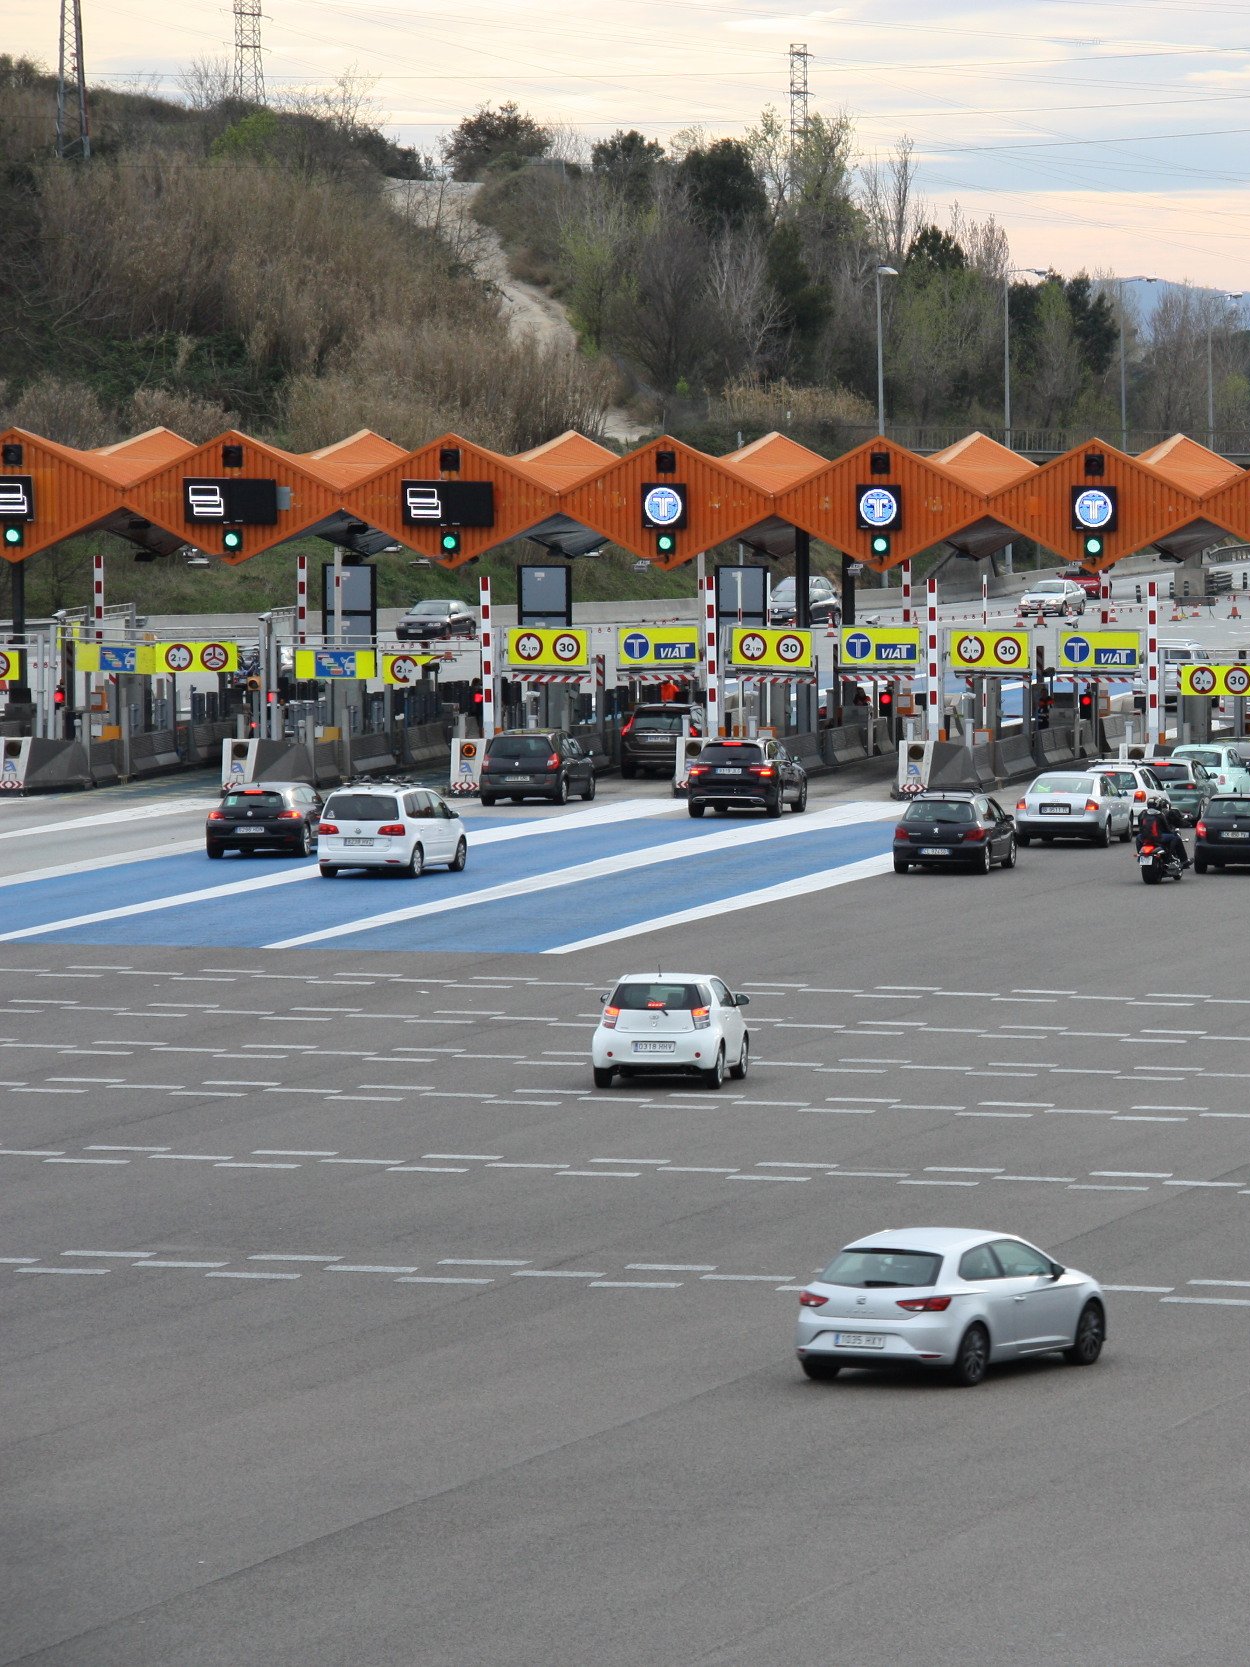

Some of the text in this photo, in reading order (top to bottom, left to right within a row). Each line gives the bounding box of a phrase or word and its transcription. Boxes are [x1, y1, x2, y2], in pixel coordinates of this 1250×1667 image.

[559, 643, 575, 652] 30
[782, 644, 798, 653] 30
[1000, 646, 1016, 655] 30
[1229, 676, 1246, 685] 30
